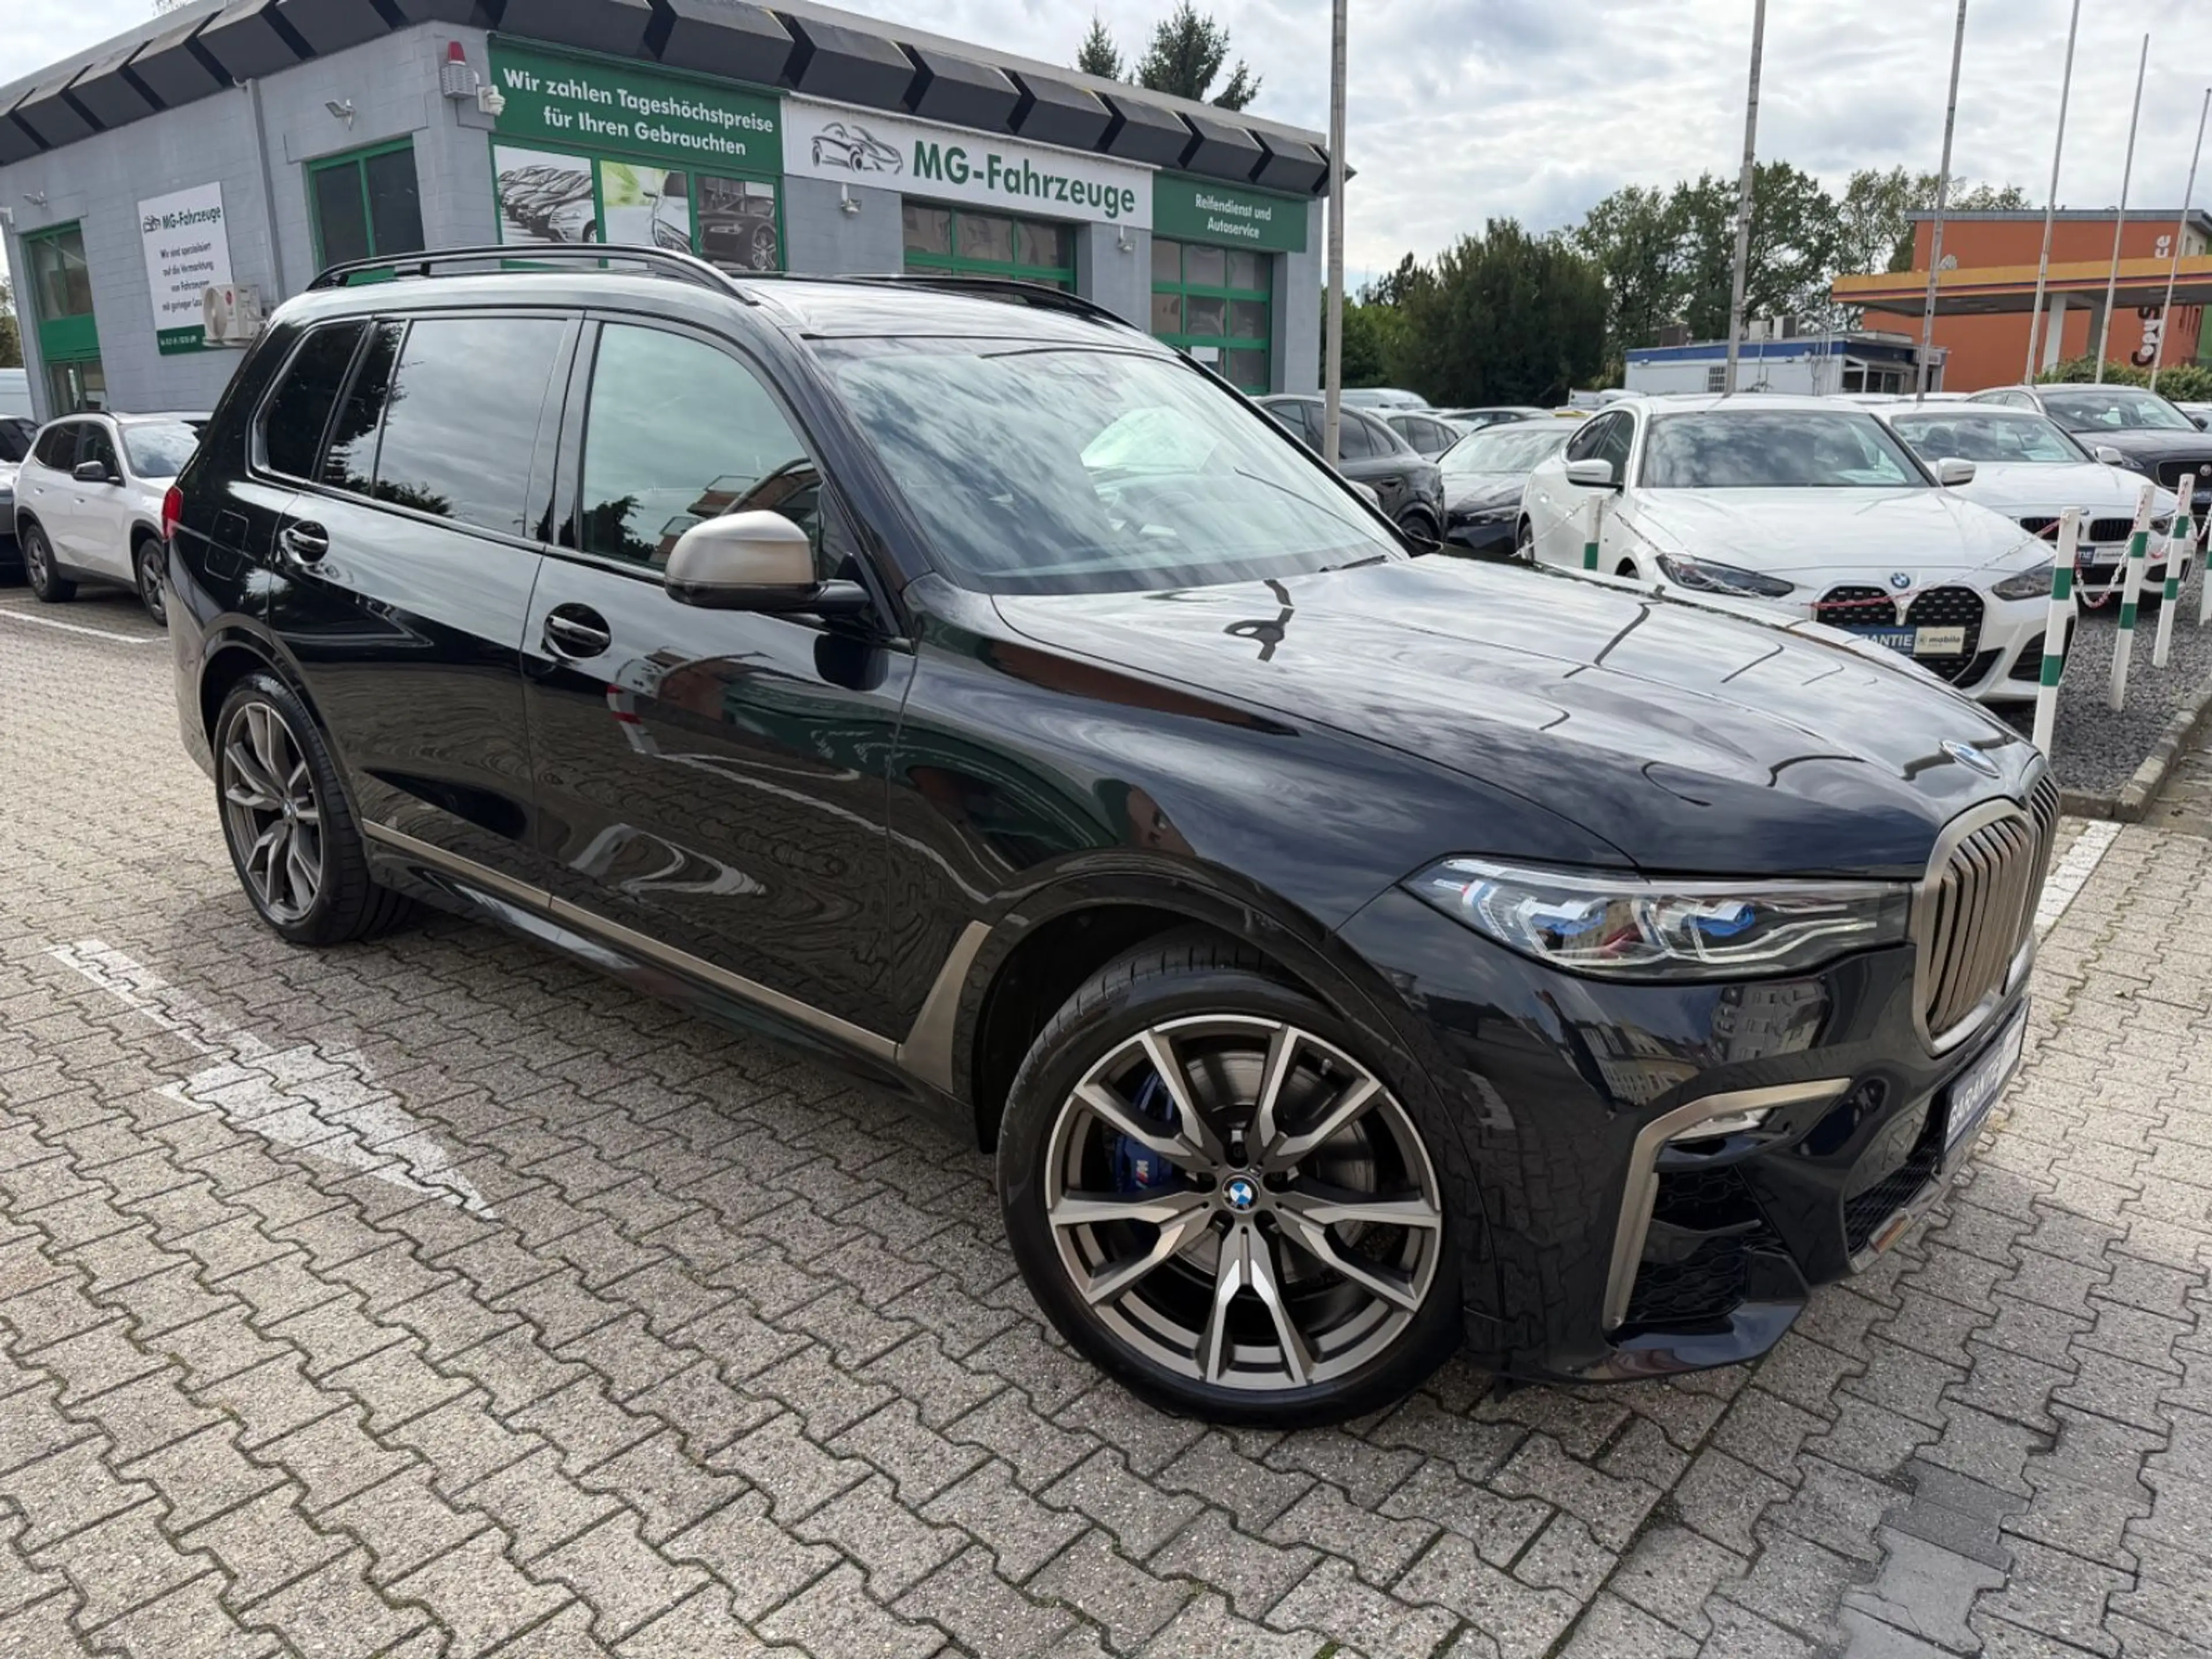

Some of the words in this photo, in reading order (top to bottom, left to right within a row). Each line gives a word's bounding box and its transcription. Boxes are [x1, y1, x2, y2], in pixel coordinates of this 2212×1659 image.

[503, 67, 540, 92] Wir
[546, 78, 612, 105] zahlen
[618, 88, 774, 134] Tageshöchstpreise
[544, 106, 573, 129] für
[578, 112, 630, 138] Ihren
[634, 123, 746, 156] Gebrauchten
[913, 140, 1135, 219] MG-Fahrzeuge
[162, 206, 222, 230] MG-Fahrzeuge
[1195, 194, 1252, 219] Reifendienst
[1254, 203, 1272, 222] und
[1207, 216, 1260, 240] Autoservice
